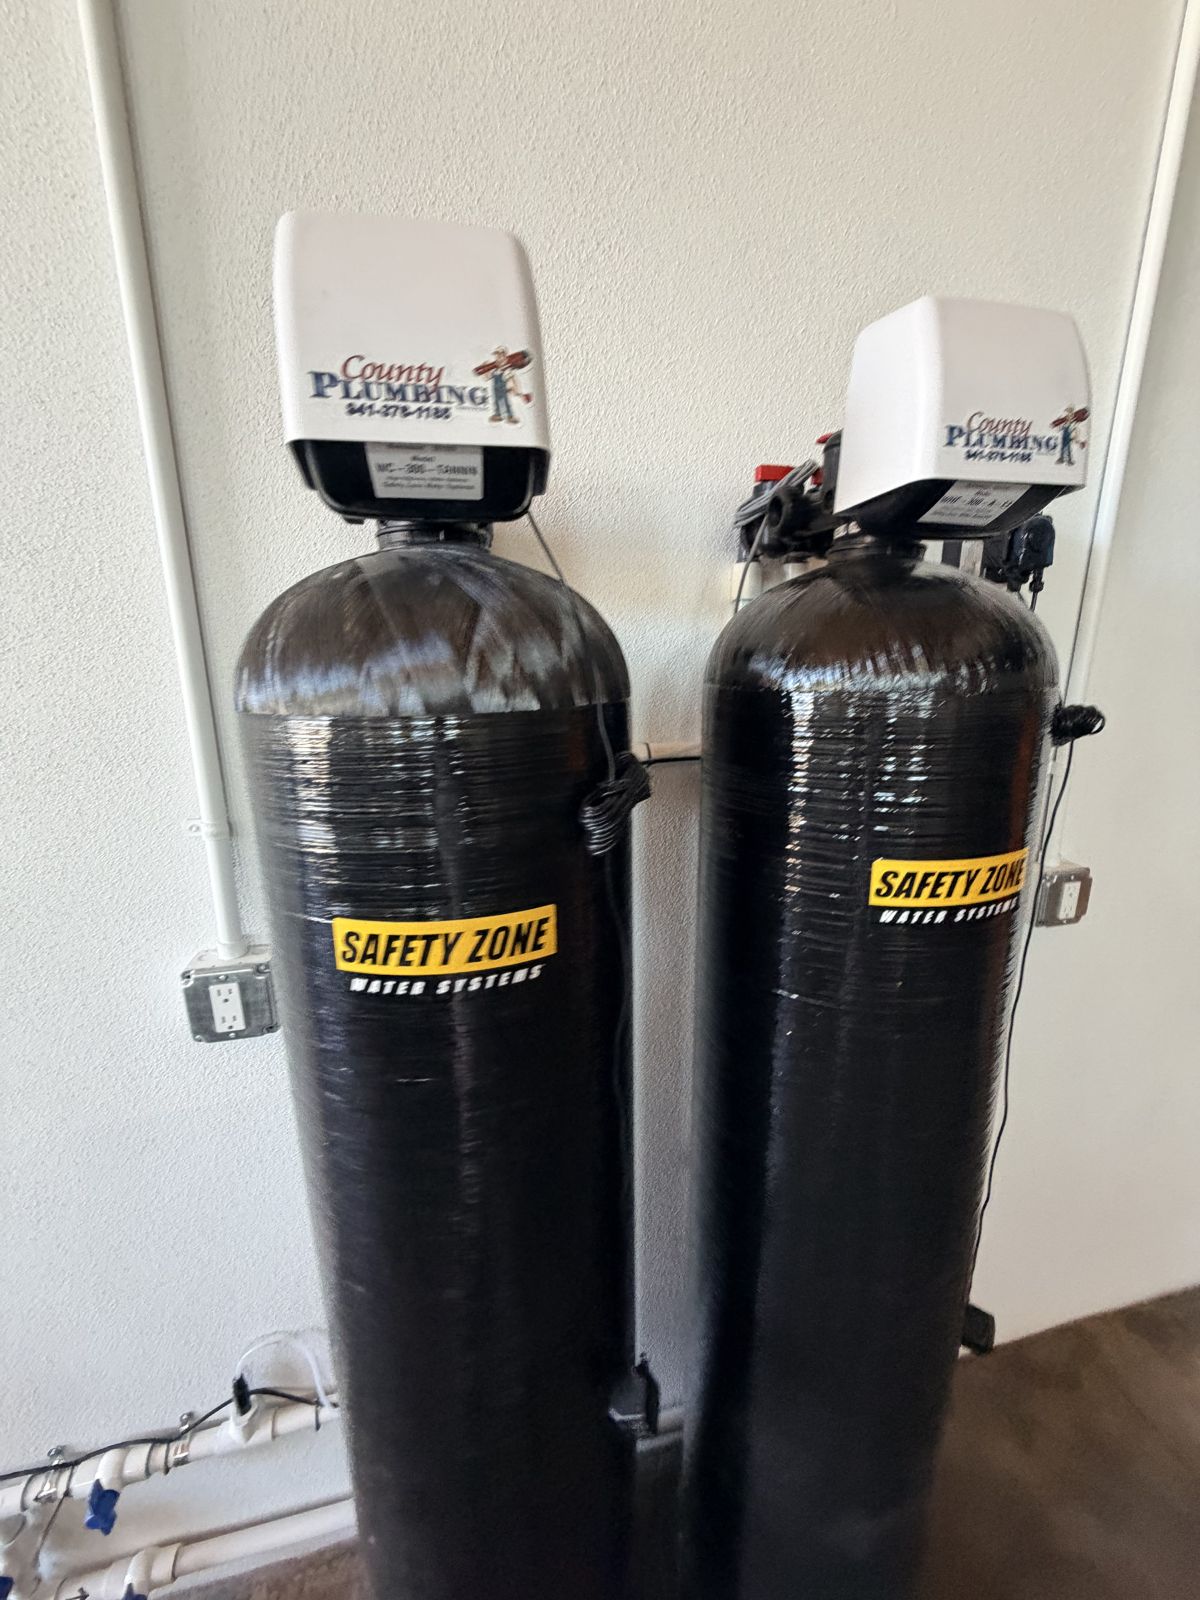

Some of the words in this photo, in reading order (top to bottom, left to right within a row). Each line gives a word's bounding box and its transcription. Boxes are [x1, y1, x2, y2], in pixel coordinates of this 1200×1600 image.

[308, 371, 489, 405] PLUMBING
[341, 354, 445, 394] County
[966, 411, 1033, 437] County
[875, 868, 981, 900] SAFETY
[978, 857, 1026, 895] ZONE
[879, 909, 948, 925] WATER
[342, 930, 465, 967] SAFETY
[466, 916, 550, 964] ZONE
[350, 977, 426, 996] WATER
[435, 964, 544, 995] SYSTEMS
